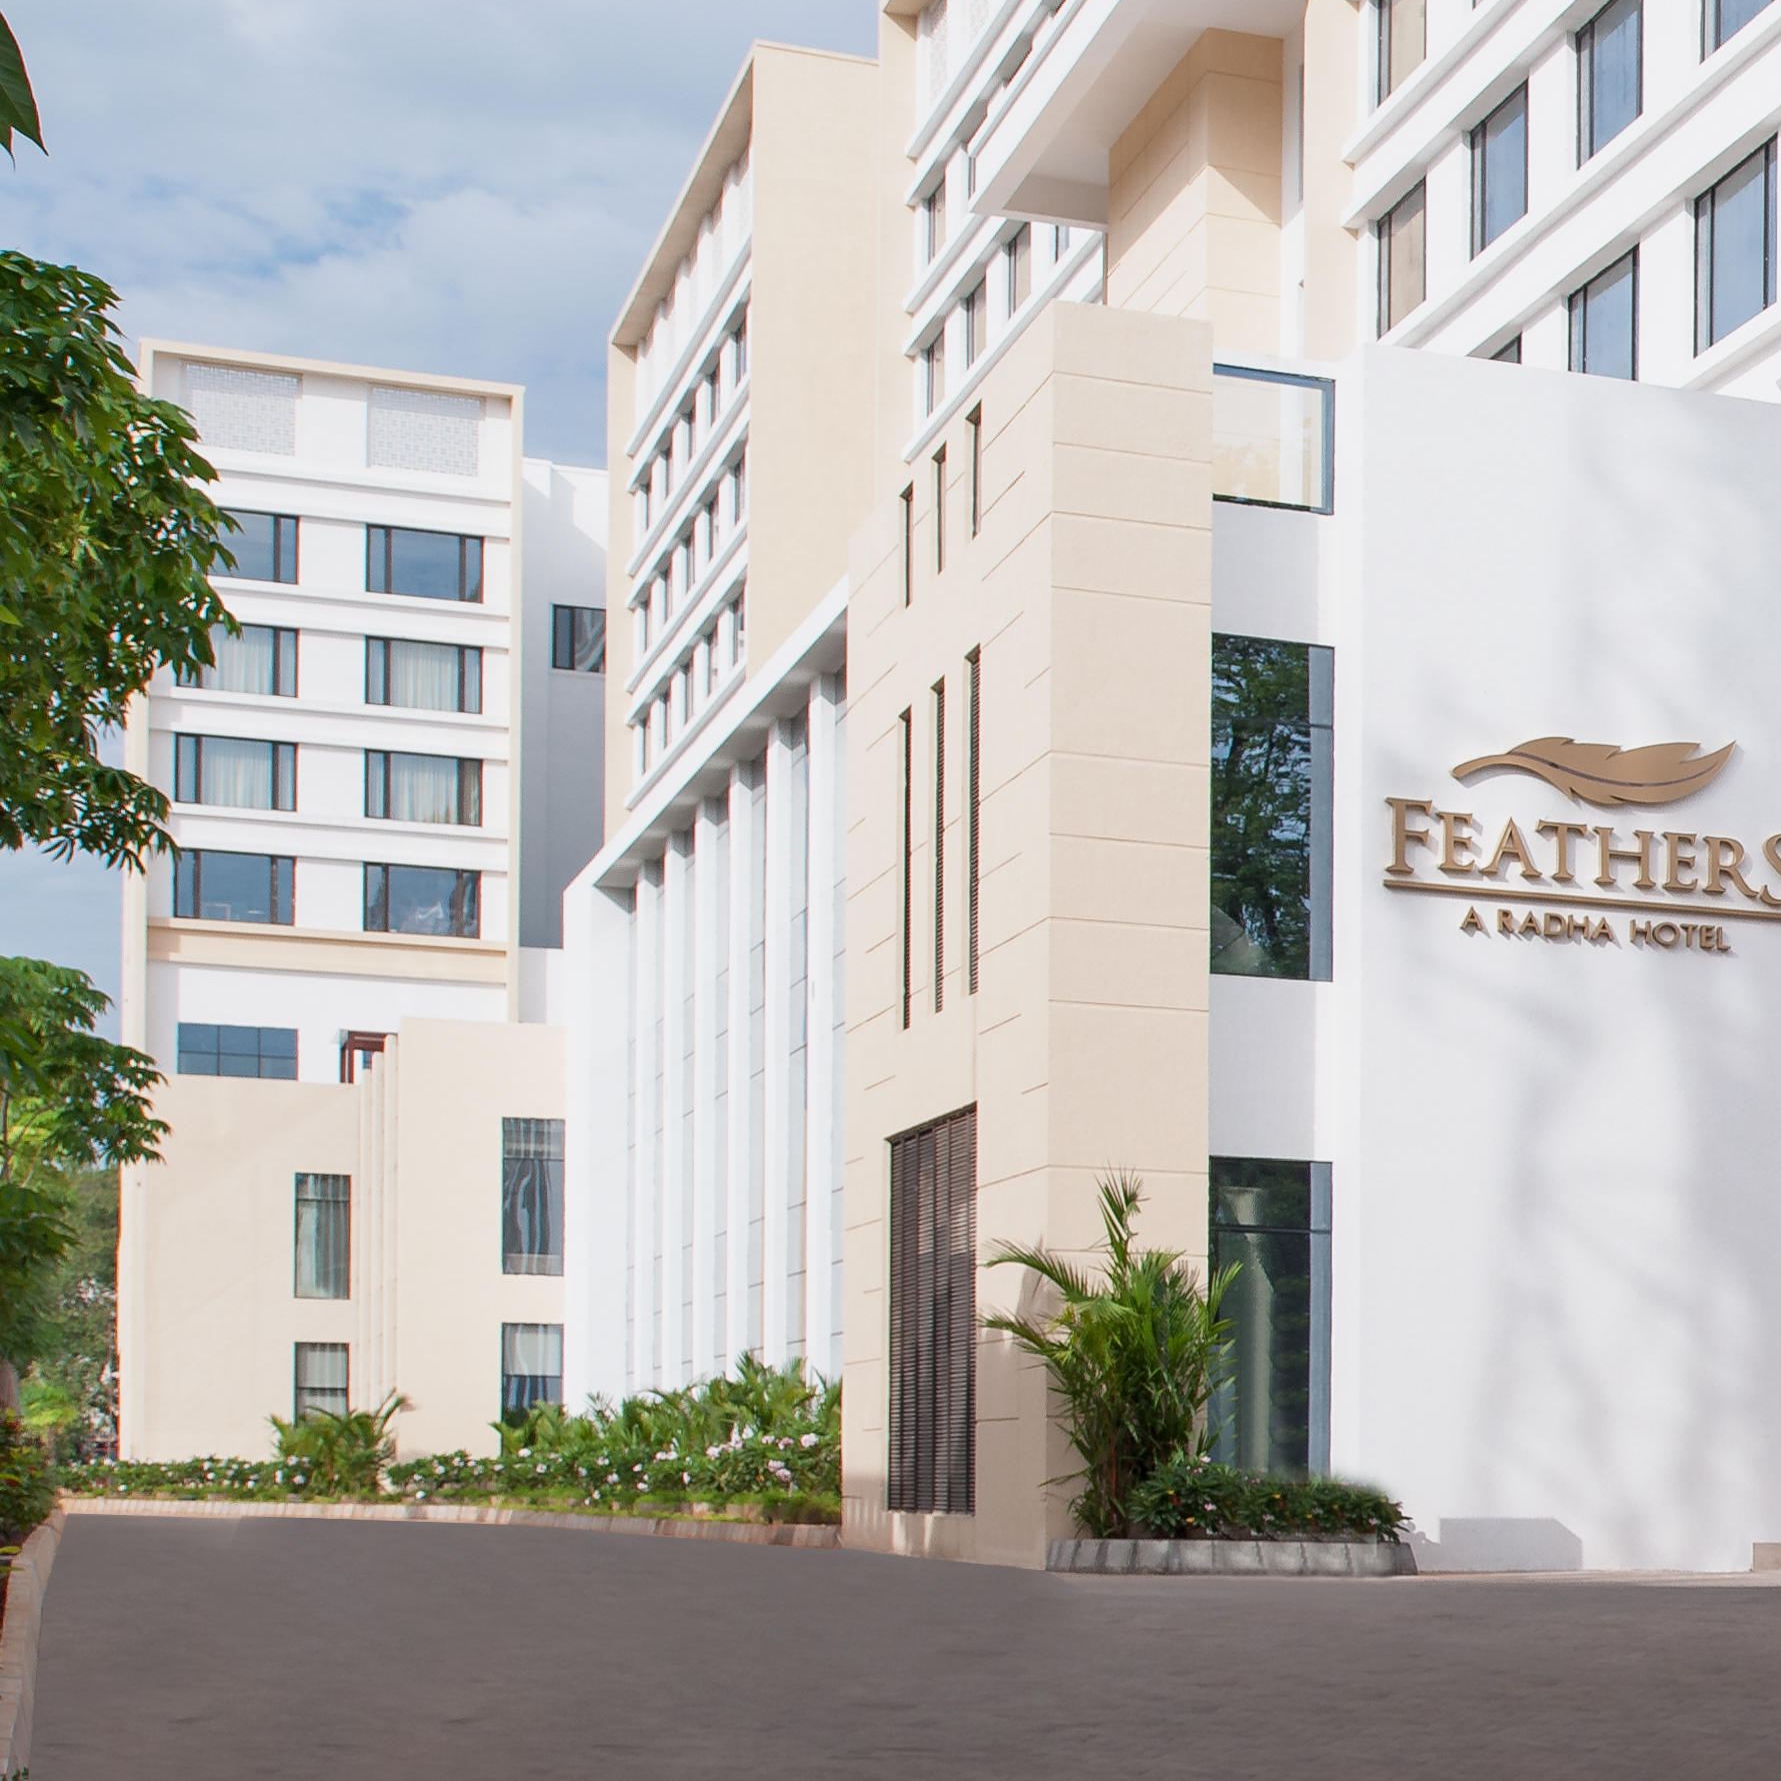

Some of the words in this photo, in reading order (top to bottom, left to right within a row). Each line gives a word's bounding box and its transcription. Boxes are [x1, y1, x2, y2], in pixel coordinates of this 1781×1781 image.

[1460, 905, 1483, 930] A
[1496, 908, 1615, 941] RADHA
[1629, 919, 1732, 951] HOTEL
